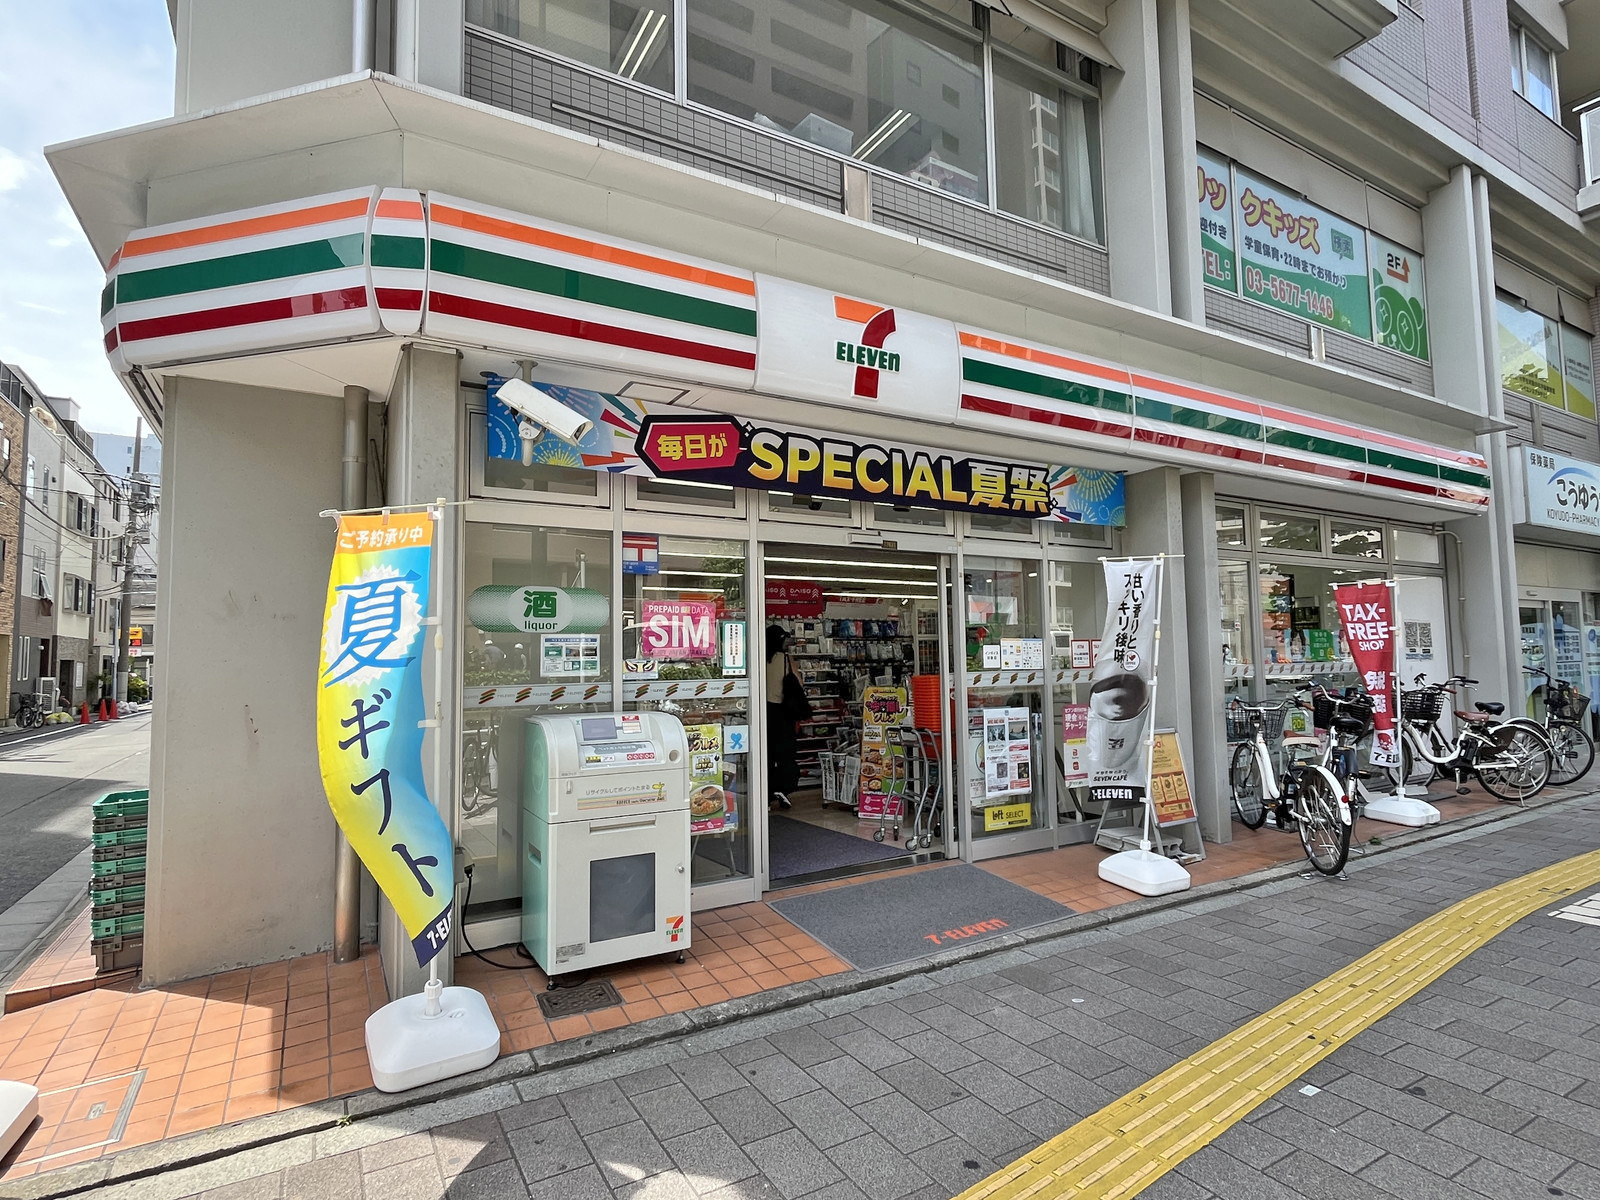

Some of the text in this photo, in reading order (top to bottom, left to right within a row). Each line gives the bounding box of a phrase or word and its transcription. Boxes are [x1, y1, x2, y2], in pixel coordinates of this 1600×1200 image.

[1241, 187, 1320, 255] クキッズ
[1387, 253, 1401, 269] 2F
[1202, 248, 1334, 320] EL: 03-5677-1446
[657, 433, 728, 460] 毎日が
[340, 526, 423, 548] ご予約承り中
[523, 590, 558, 618] 酒
[648, 605, 680, 613] PREPAID
[691, 606, 710, 614] DATA
[1127, 573, 1145, 650] 甘い香りと
[1341, 603, 1386, 621] TAX-
[524, 620, 558, 631] liquor
[649, 614, 710, 648] SIM
[1346, 621, 1389, 640] FREE
[1359, 640, 1385, 651] SHOP
[1005, 810, 1024, 819] SELECT
